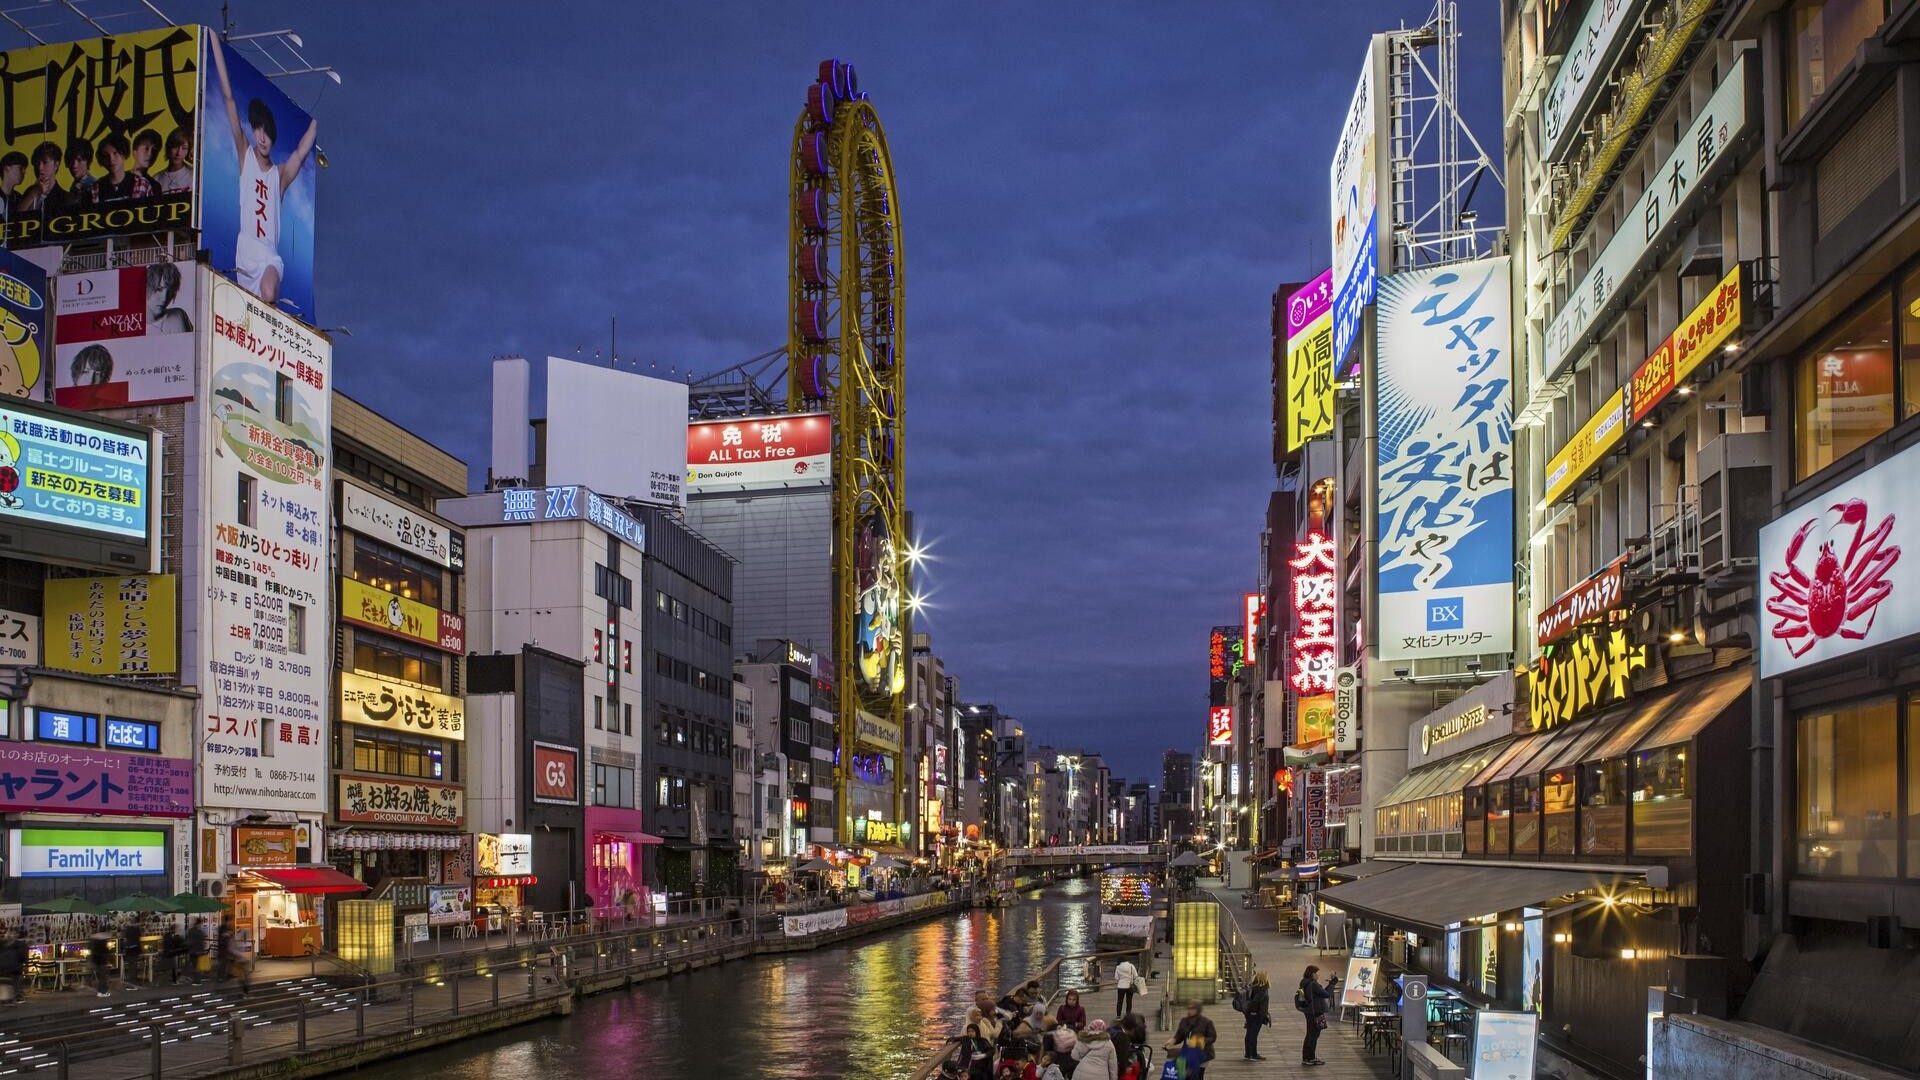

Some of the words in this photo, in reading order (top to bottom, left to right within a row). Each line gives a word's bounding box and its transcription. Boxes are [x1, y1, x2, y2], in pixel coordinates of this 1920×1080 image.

[1644, 113, 1716, 245] 白木屋
[50, 202, 190, 234] GROUP
[255, 178, 269, 239] ホスト
[1558, 266, 1606, 358] 白木屋
[215, 314, 323, 391] 日本原カンツリー倶楽部
[271, 328, 323, 365] チャンピオンコース
[1292, 338, 1313, 443] バイト
[1312, 326, 1333, 433] 高収入
[13, 418, 143, 460] 就職活動中の皆様へ
[708, 450, 732, 462] ALL
[736, 447, 761, 460] Tax
[765, 445, 796, 458] Free
[31, 470, 136, 505] 新卒の方を募集
[650, 471, 681, 482] スポンサー募集中
[715, 470, 742, 479] Quijote
[35, 492, 134, 524] しております。
[261, 490, 321, 527] ネット申込みで、
[503, 487, 578, 521] 無双
[215, 564, 258, 589] 中国自動車道
[253, 592, 283, 613] 5,200円
[1288, 532, 1336, 693] 大阪王将
[1431, 605, 1459, 622] BX
[1538, 575, 1621, 638] ハンバーグレストラン
[230, 623, 251, 640] 土日祝
[252, 622, 283, 643] 7,800円
[441, 613, 462, 632] 17:00
[69, 613, 85, 659] 応援します
[234, 651, 256, 665] ロッジ
[278, 660, 311, 677] 3,780円
[257, 685, 273, 699] 平日
[1528, 628, 1646, 730] びっくりドンキー
[257, 701, 273, 714] 平日
[362, 686, 435, 729] うなぎ
[1338, 689, 1349, 720] ZERO
[53, 716, 70, 738] 酒
[108, 723, 144, 745] たばこ
[208, 714, 258, 738] コスパ
[206, 742, 259, 758] 幹部スタッフ募集
[214, 763, 247, 778] 予約受付
[269, 769, 316, 782] 0868-75-1144
[545, 761, 566, 788] G3
[213, 783, 317, 800] http://www.nihonbaracc.com
[347, 782, 363, 799] 本場
[368, 783, 430, 813] お好み焼
[351, 798, 368, 815] 大阪
[373, 812, 428, 823] OKONOMIYAKI
[48, 848, 142, 870] FamilyMart
